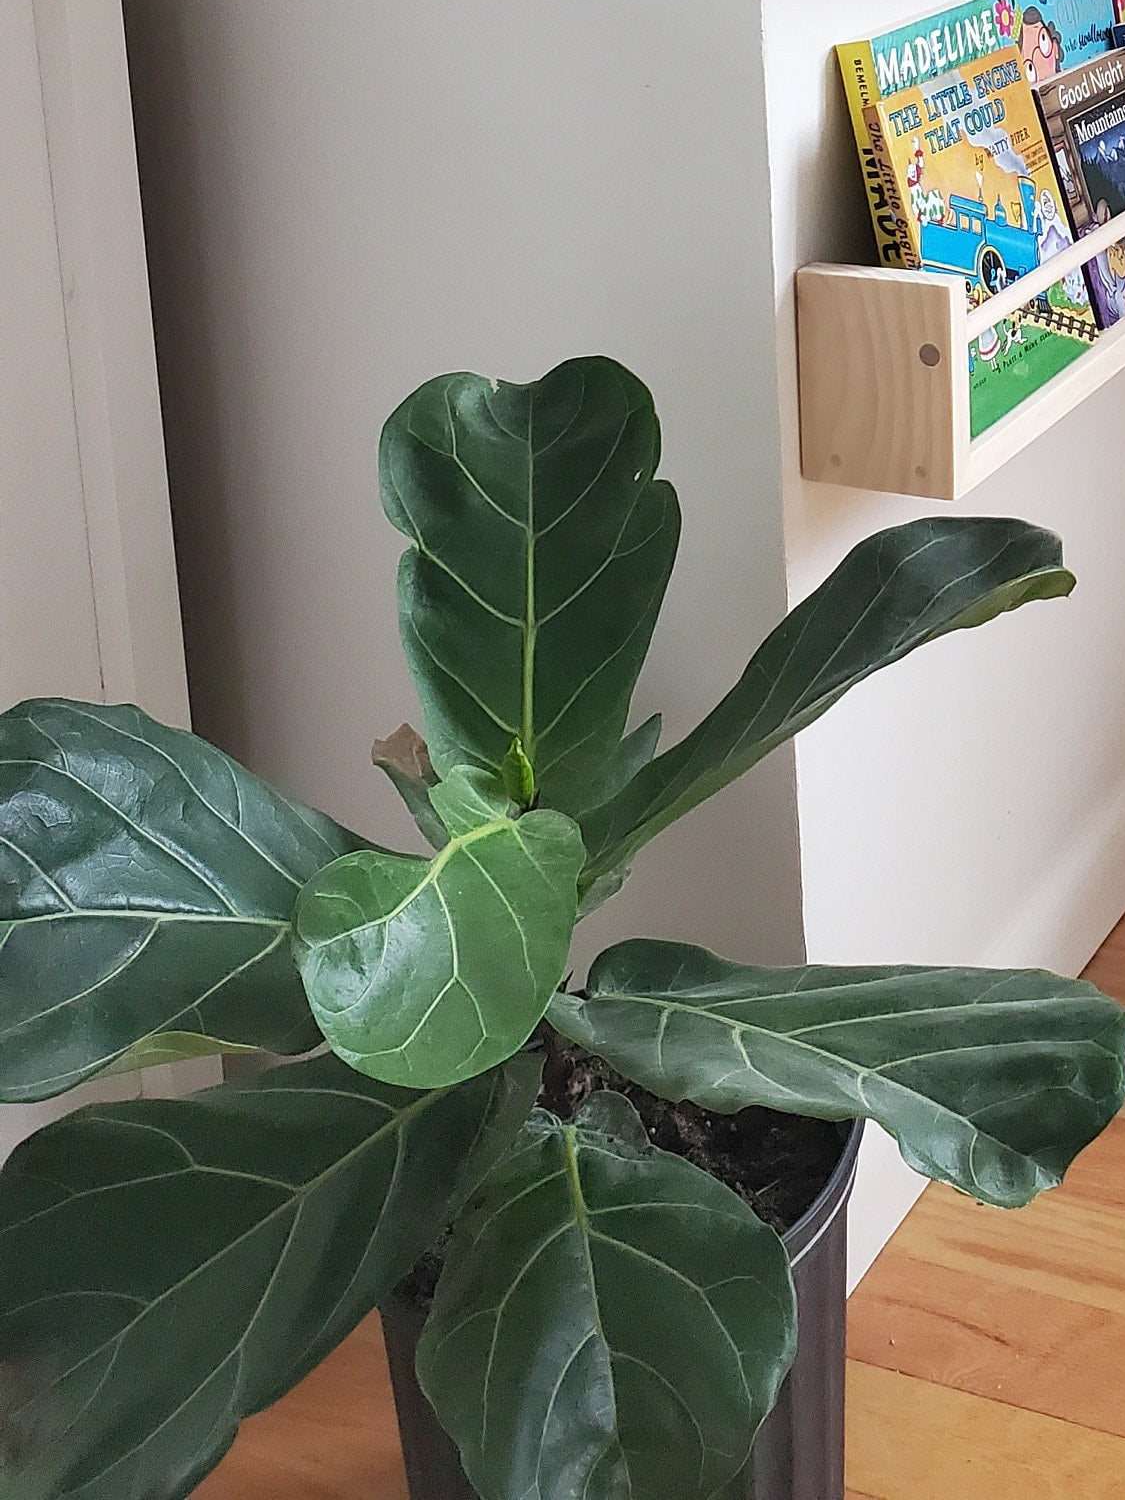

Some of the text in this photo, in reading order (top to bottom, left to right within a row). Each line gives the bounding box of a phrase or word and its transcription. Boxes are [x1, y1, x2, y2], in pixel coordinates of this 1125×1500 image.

[876, 9, 997, 90] MADELINE
[888, 57, 1022, 137] THE LITTLE ENGINE
[1058, 60, 1124, 109] Good Night
[924, 97, 1006, 155] THAT COULD
[974, 126, 1031, 172] by WATTY PIPER
[868, 121, 884, 152] The
[878, 161, 901, 211] Little
